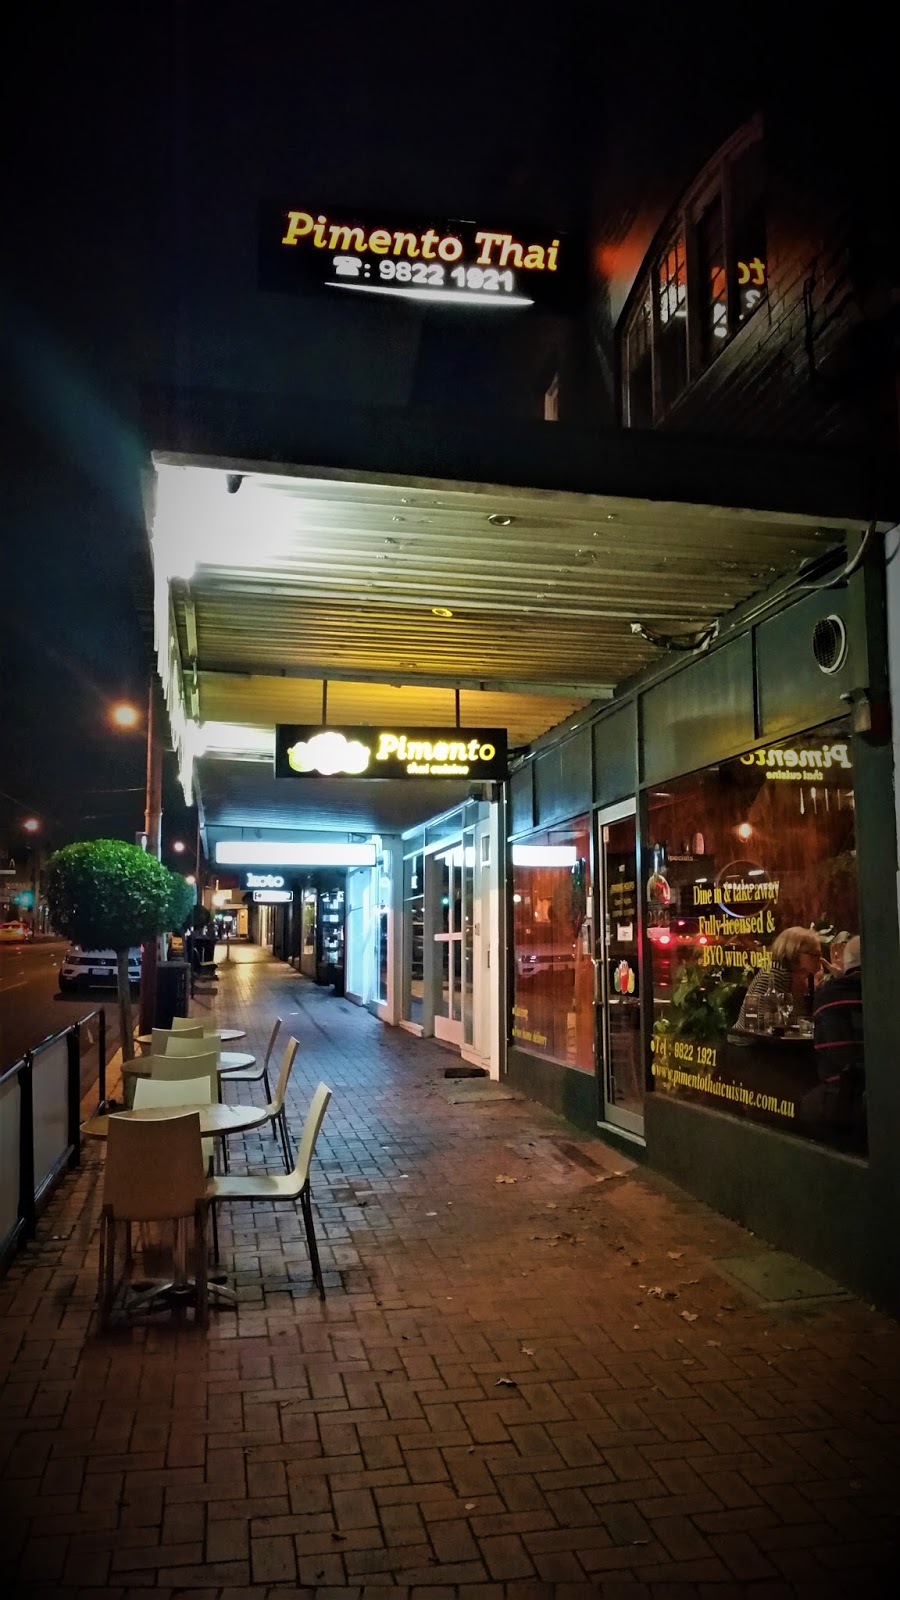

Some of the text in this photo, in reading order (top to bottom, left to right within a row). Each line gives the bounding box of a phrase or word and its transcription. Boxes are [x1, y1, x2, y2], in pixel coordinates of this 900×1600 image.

[282, 211, 560, 271] Pimento Thai
[379, 260, 445, 286] 9822
[376, 733, 496, 761] Pimento
[693, 879, 780, 905] Dine in & take away
[766, 910, 776, 934] &
[702, 945, 774, 974] BYO wine only
[674, 1041, 694, 1062] 9822
[696, 1046, 717, 1067] 1921
